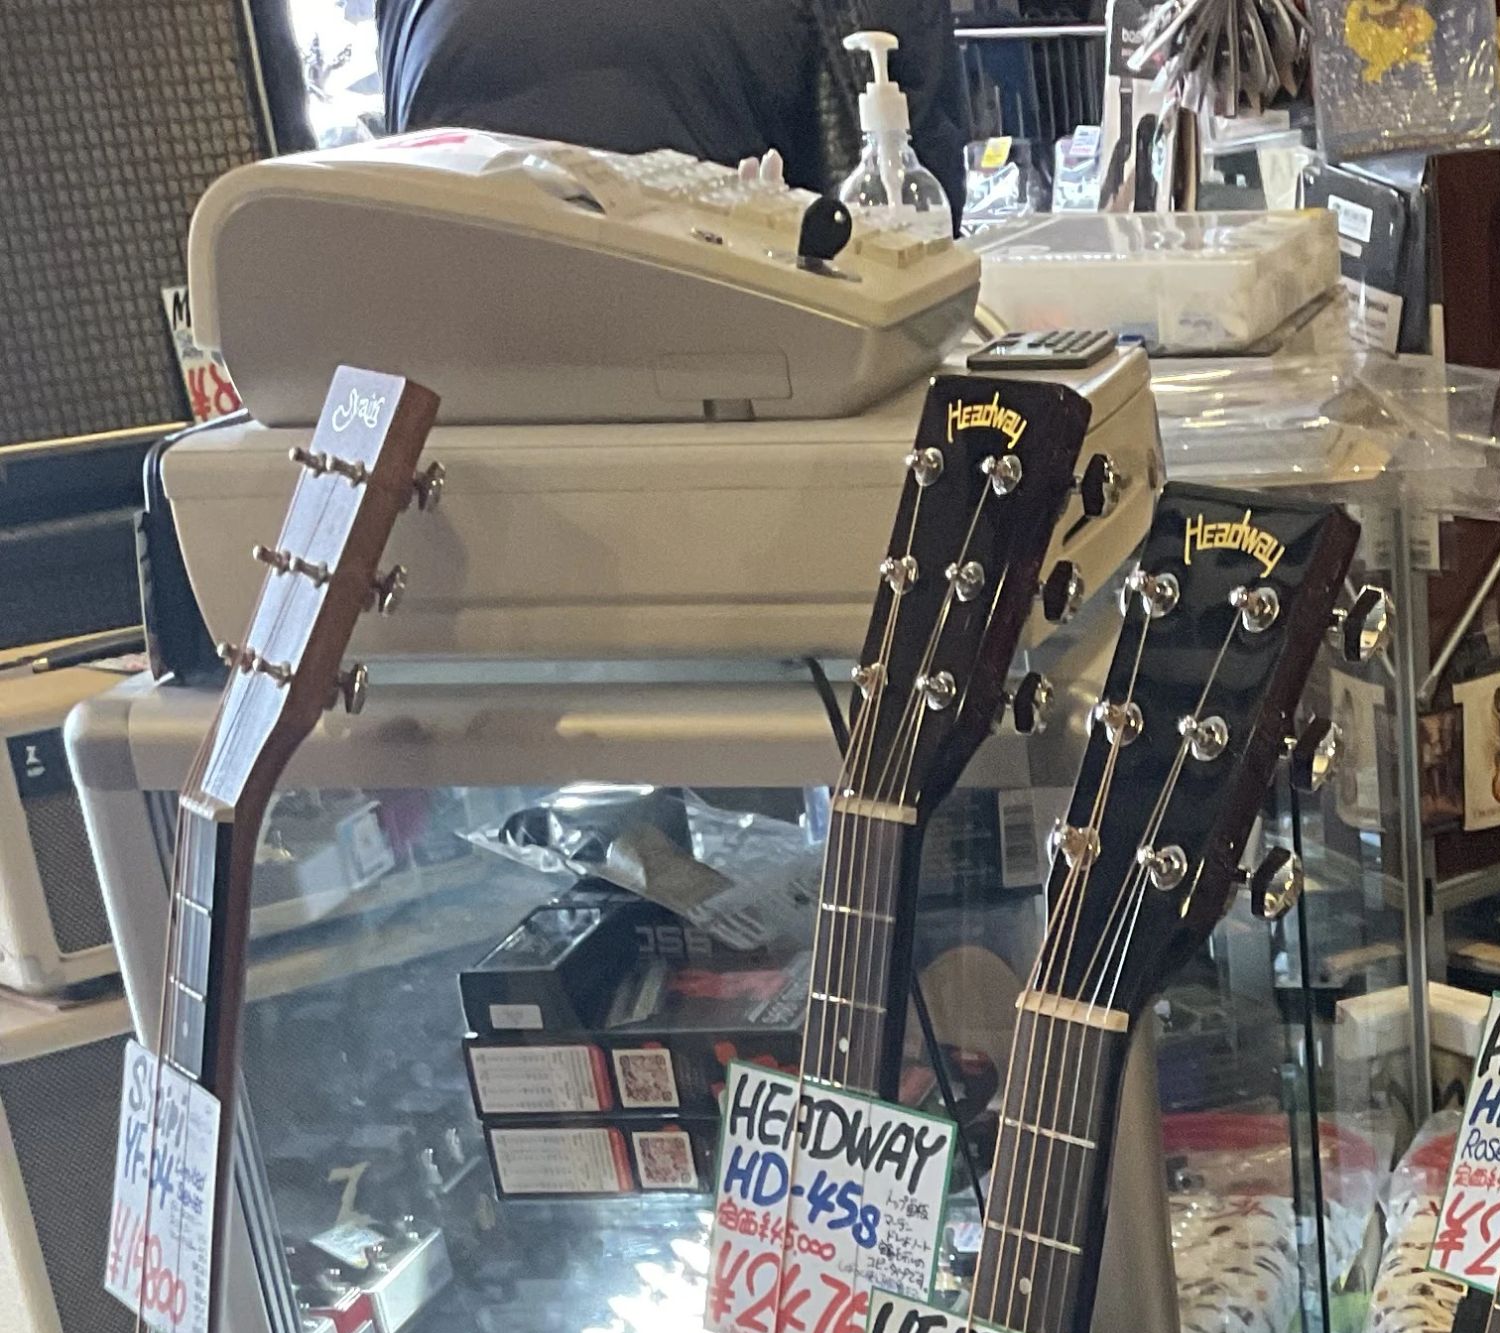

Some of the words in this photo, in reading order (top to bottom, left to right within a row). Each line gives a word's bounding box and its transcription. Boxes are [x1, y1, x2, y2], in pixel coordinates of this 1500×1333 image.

[948, 392, 1028, 449] Headway
[1184, 510, 1286, 578] Headway
[729, 1073, 948, 1194] HEADWAY
